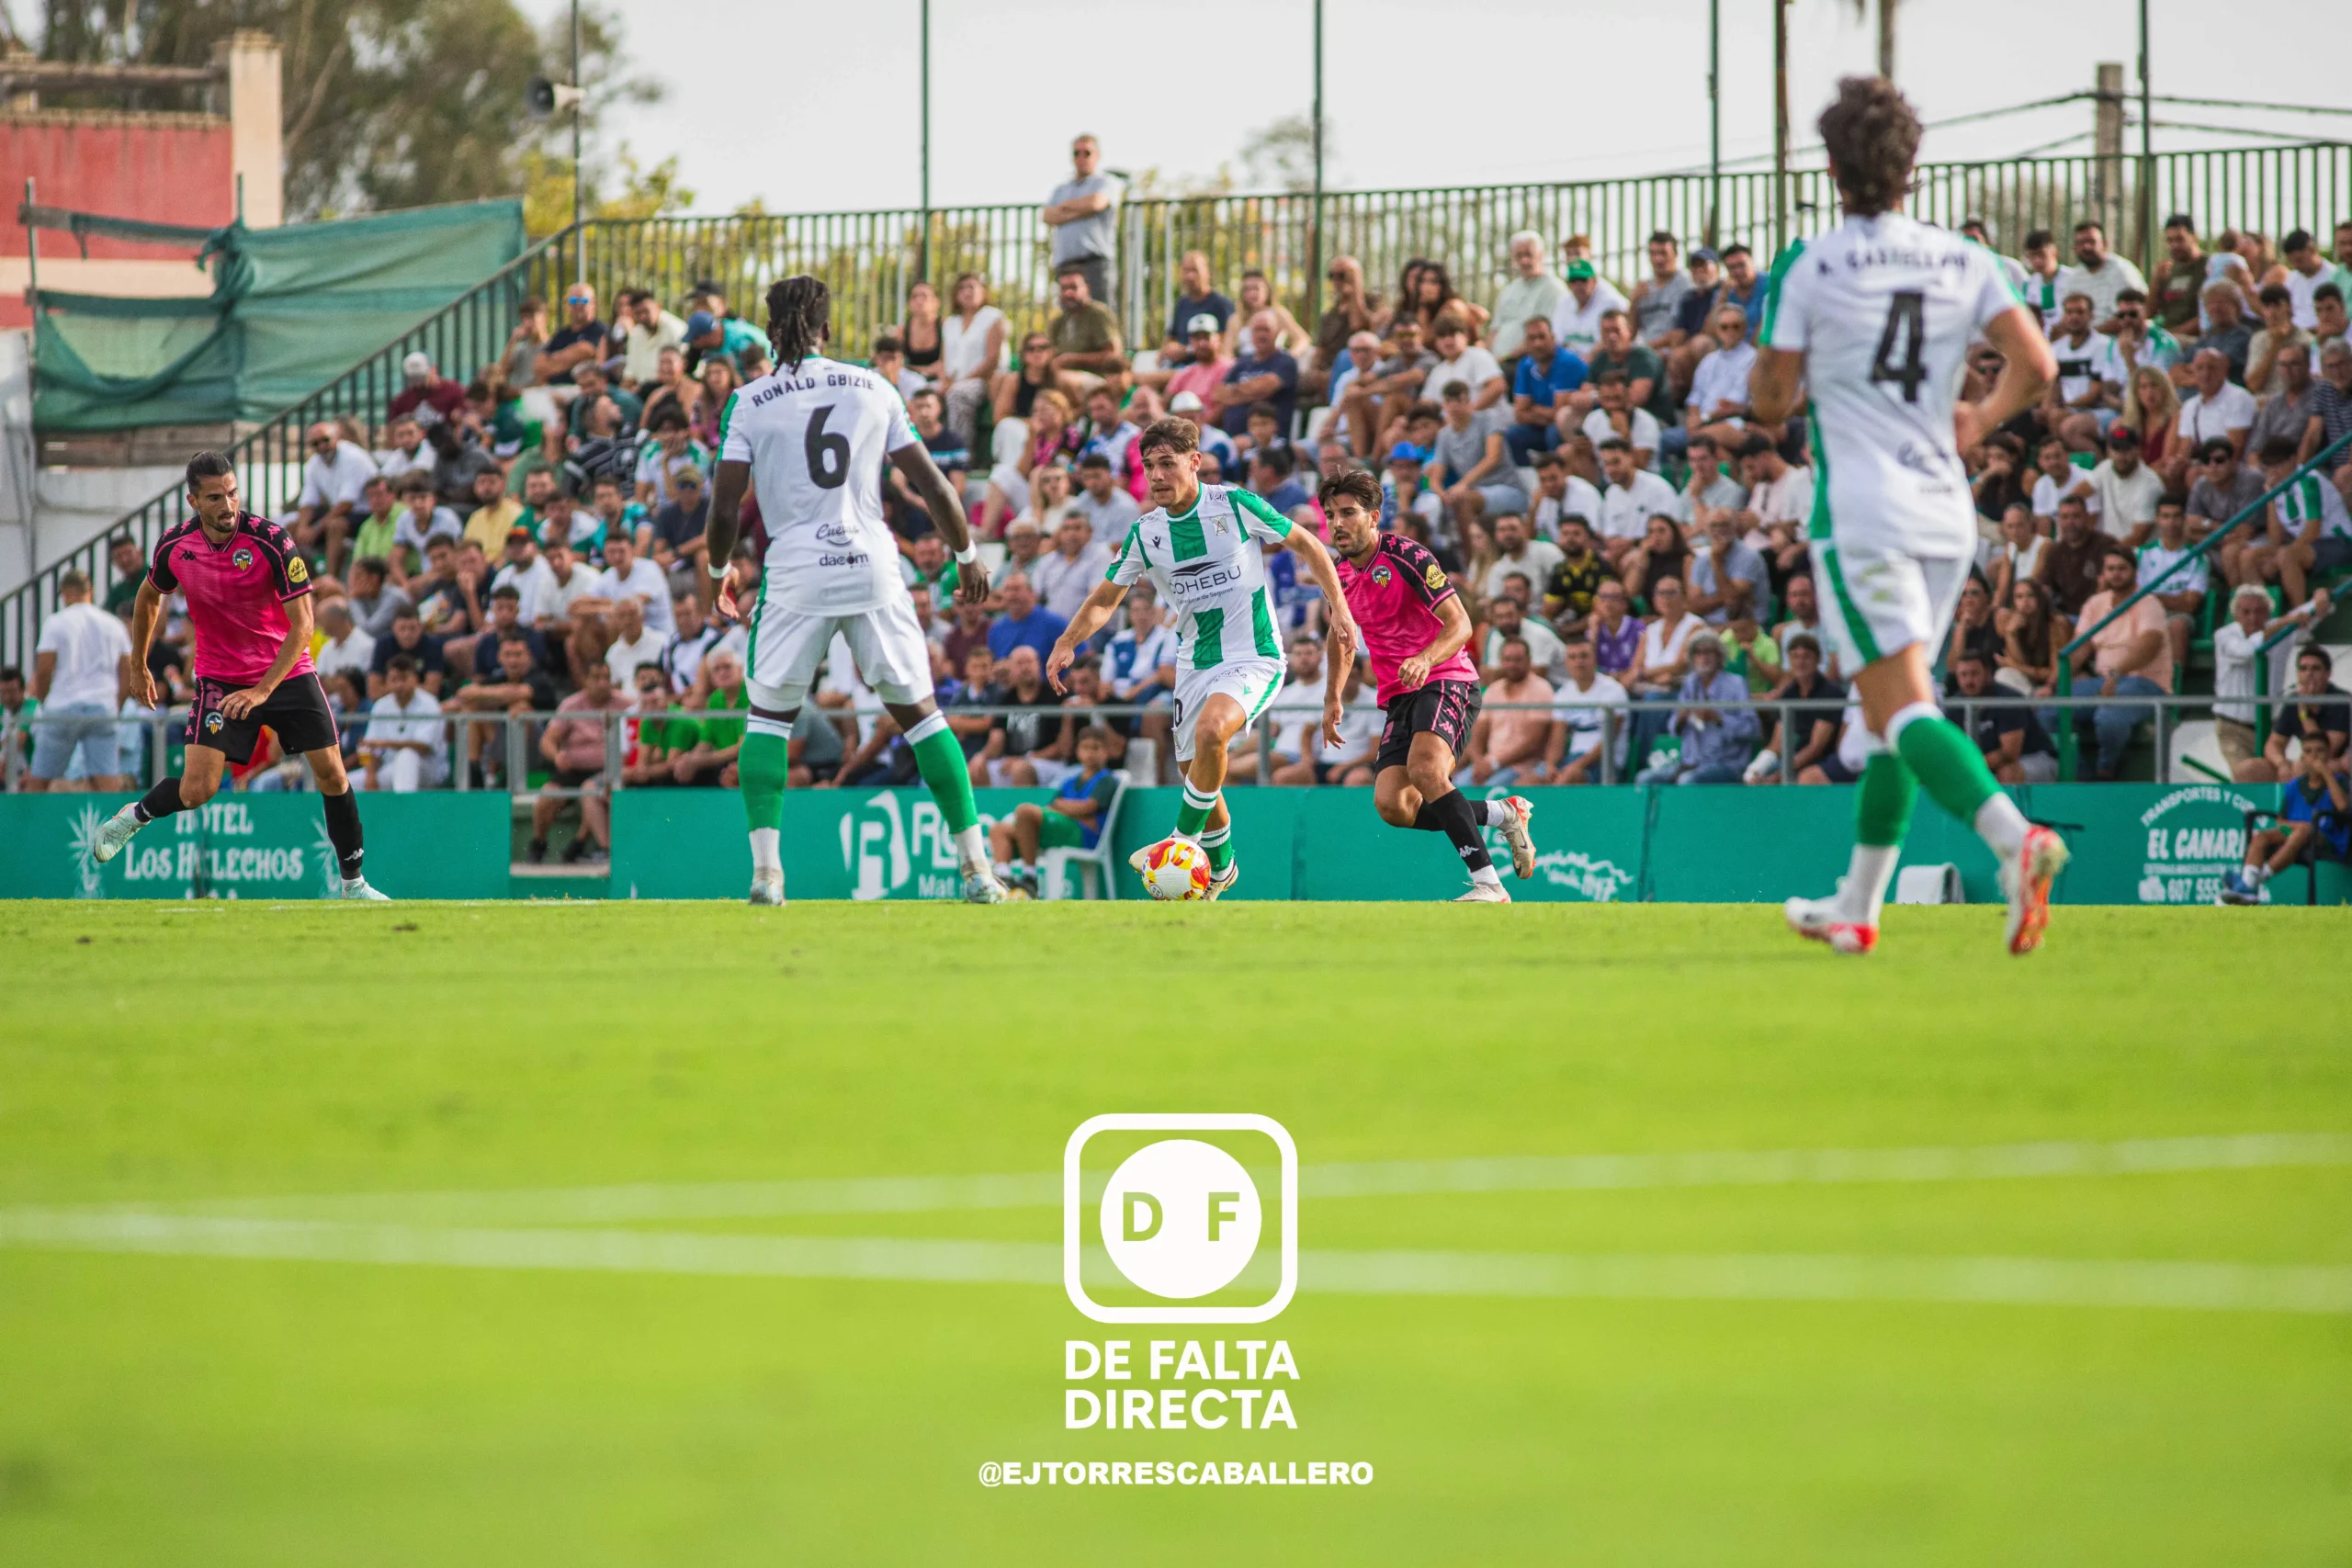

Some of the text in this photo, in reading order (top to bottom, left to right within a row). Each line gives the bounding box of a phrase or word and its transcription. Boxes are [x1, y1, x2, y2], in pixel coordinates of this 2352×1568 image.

[1872, 291, 1928, 402] 4
[752, 374, 875, 407] RONALD GBIZIE
[804, 403, 852, 490] 6
[2140, 785, 2222, 828] TRANSPORTES
[2147, 828, 2247, 860] EL CANARI
